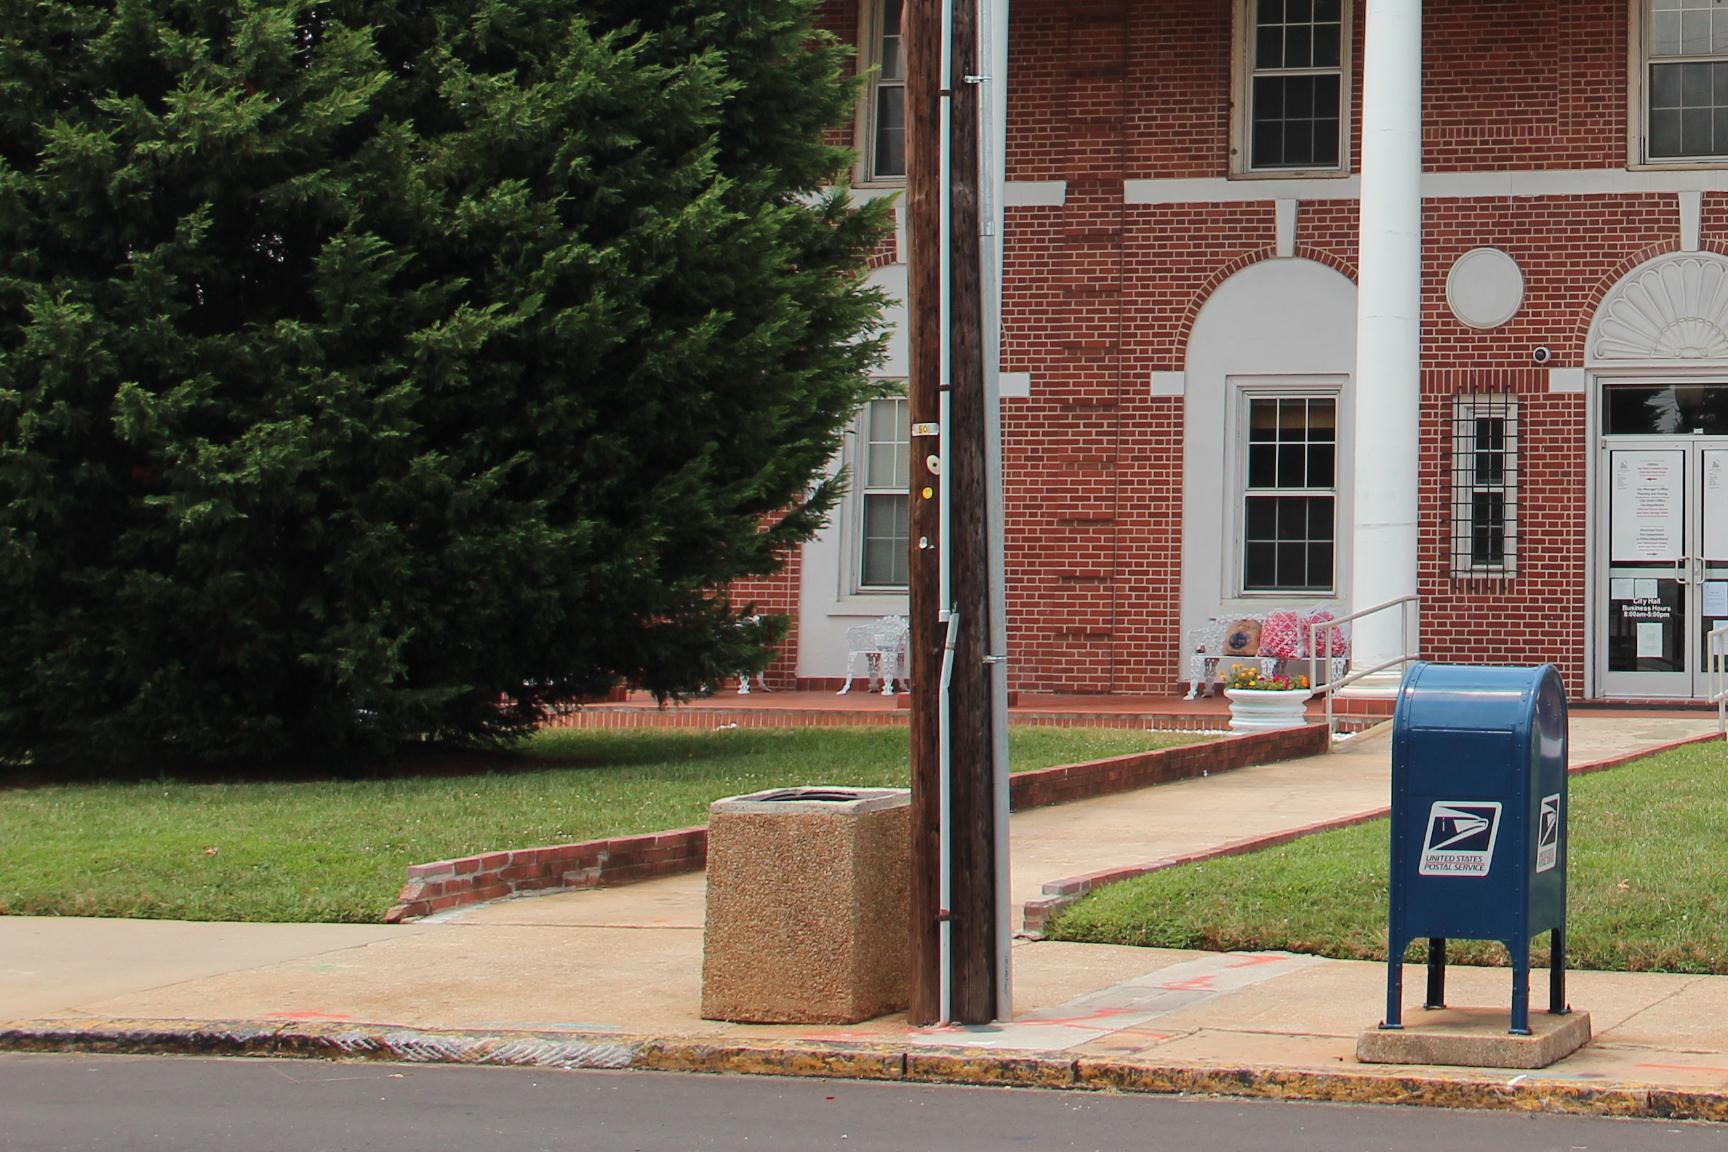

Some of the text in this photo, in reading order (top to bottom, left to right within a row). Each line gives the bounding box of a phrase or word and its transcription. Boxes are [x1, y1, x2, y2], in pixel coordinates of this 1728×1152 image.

[1456, 855, 1483, 863] STATES
[1424, 863, 1485, 872] POSTAL SERVICE
